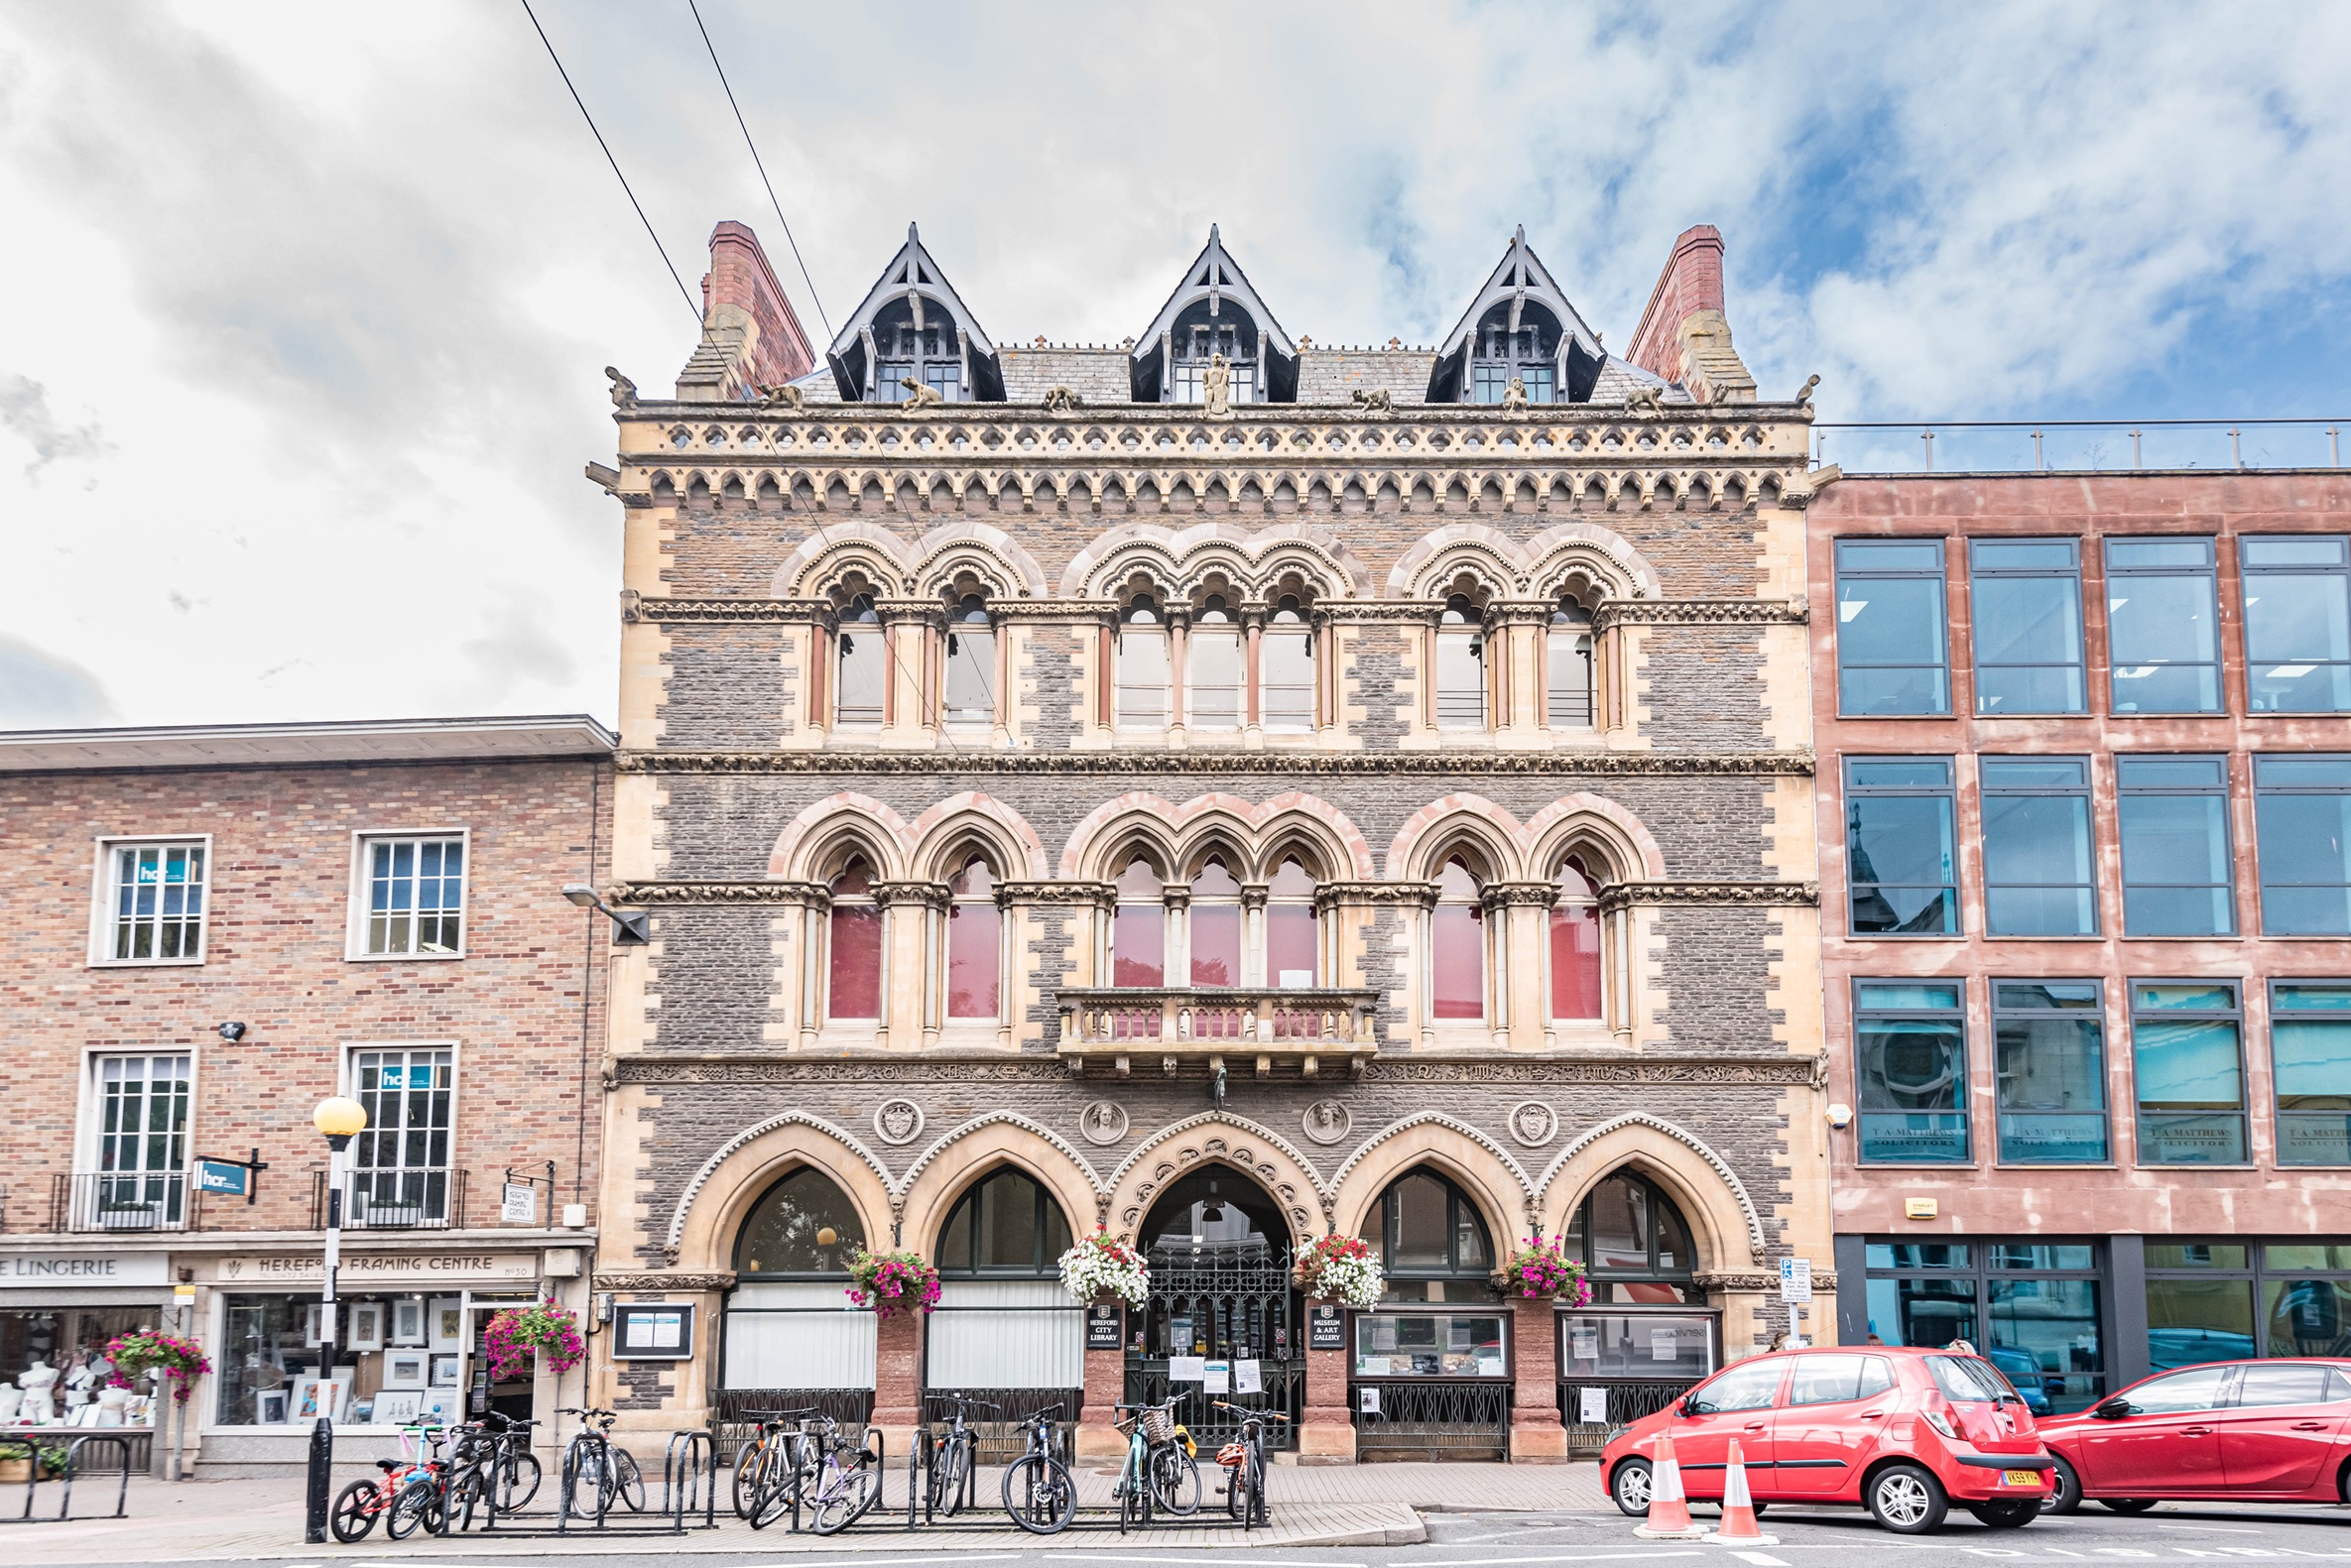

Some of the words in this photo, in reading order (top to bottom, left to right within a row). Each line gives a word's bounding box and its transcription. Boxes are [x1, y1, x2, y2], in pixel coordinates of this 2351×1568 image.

[141, 867, 169, 881] hc
[383, 1071, 412, 1086] hc
[202, 1170, 227, 1187] hcr
[16, 1258, 117, 1275] LINGERIE
[350, 1258, 422, 1270] FRAMING
[429, 1257, 493, 1270] CENTRE
[2005, 1472, 2026, 1484] VK59
